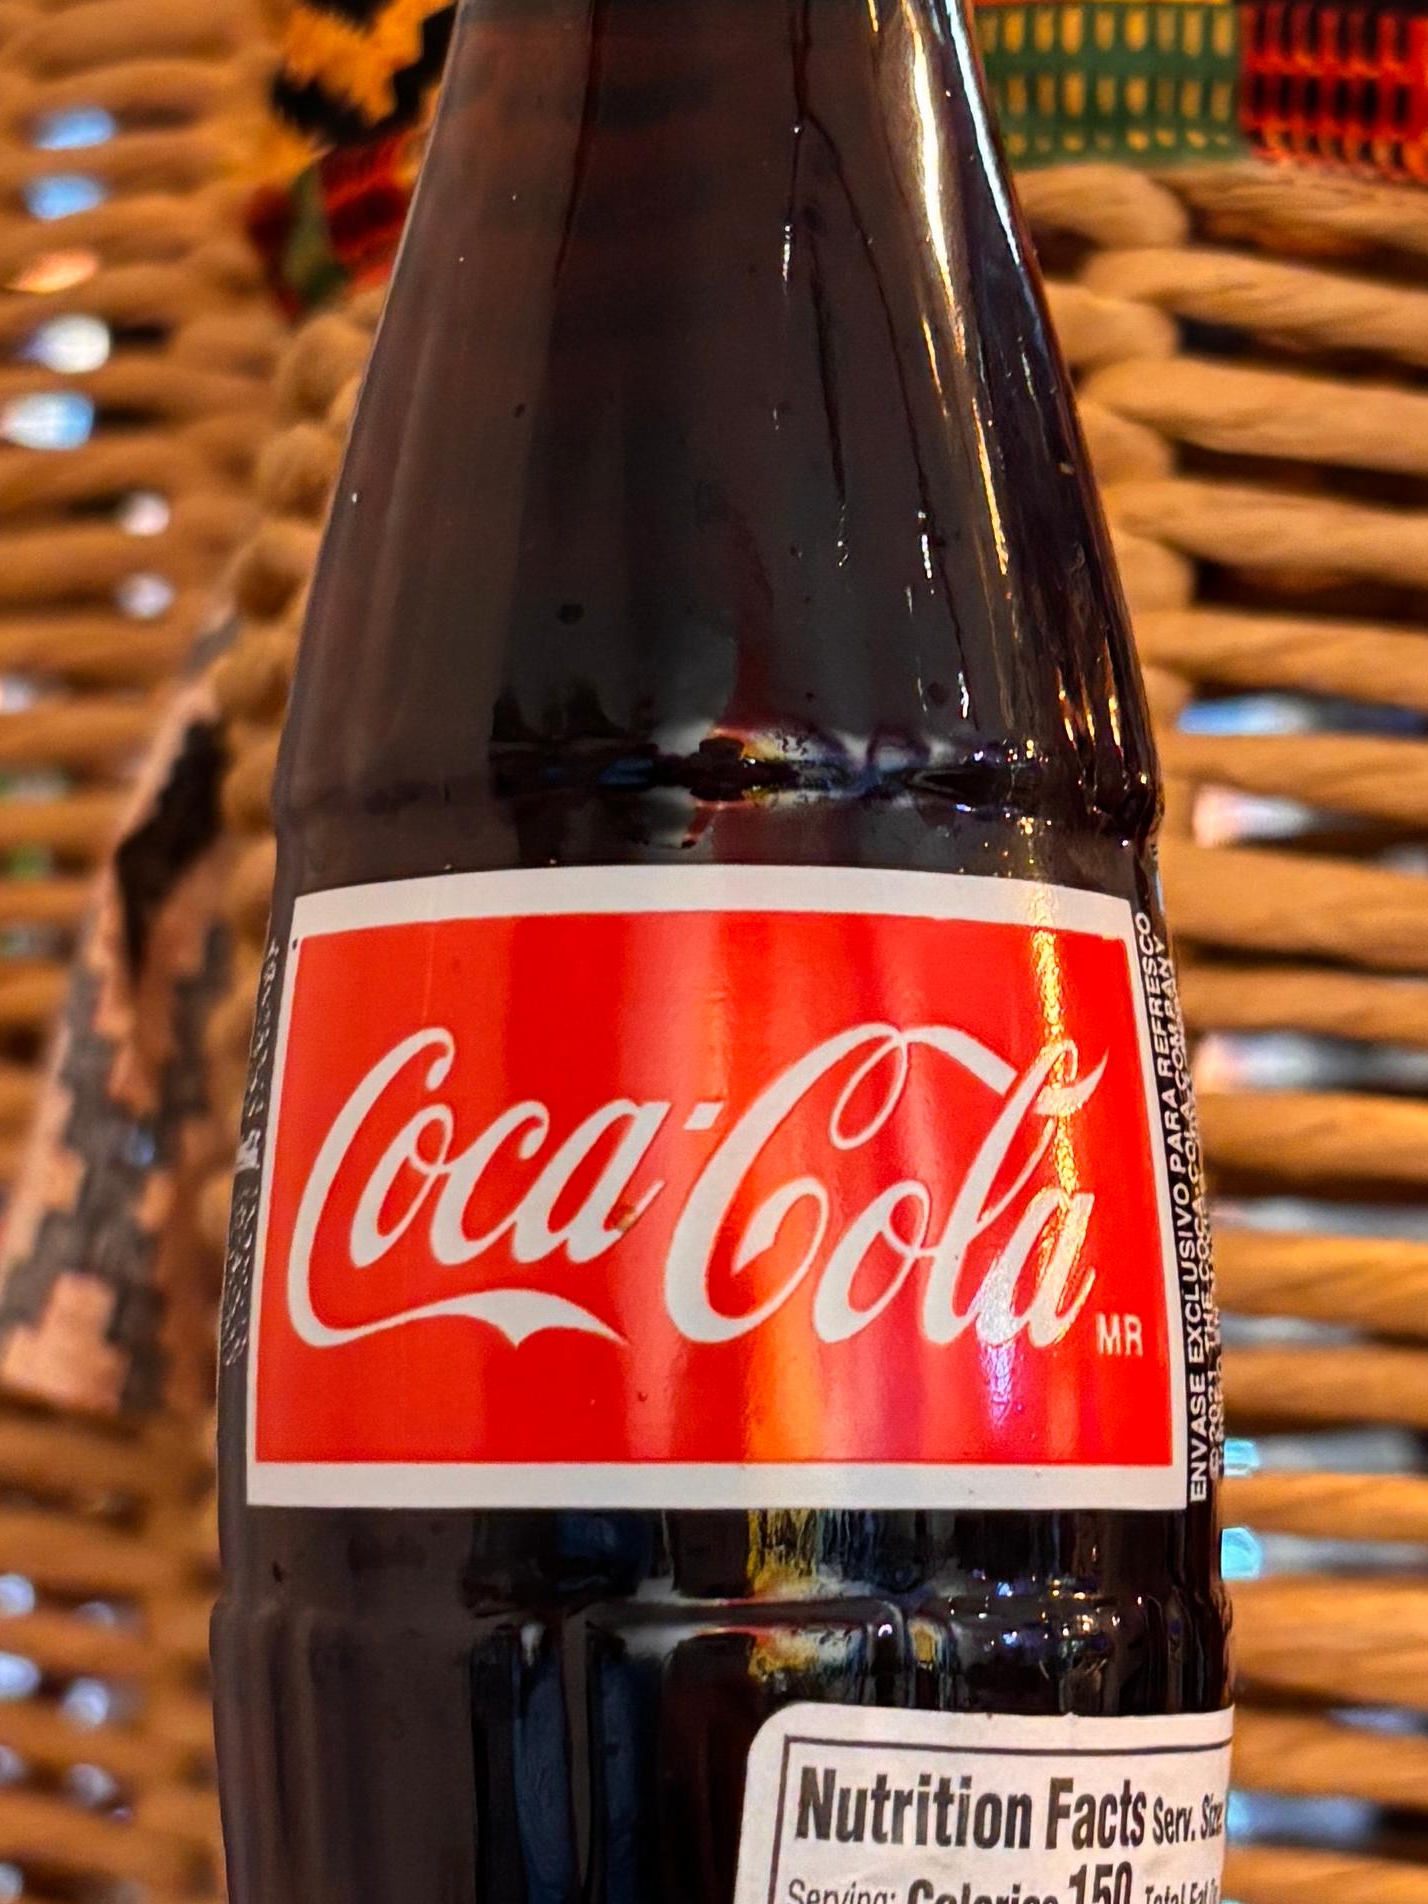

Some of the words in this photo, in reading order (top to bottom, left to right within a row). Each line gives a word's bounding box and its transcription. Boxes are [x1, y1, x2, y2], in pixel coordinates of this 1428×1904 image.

[1135, 911, 1174, 1078] REFRESCO
[287, 1022, 1109, 1349] Coca-Cola
[1162, 1088, 1186, 1174] PARA
[1097, 1313, 1144, 1357] MR
[1172, 1182, 1205, 1364] EXCLUSIVO
[1190, 1373, 1208, 1502] ENVASE
[795, 1766, 1031, 1849] Nutrition
[1045, 1777, 1147, 1850] Facts
[1153, 1796, 1196, 1845] Serv.
